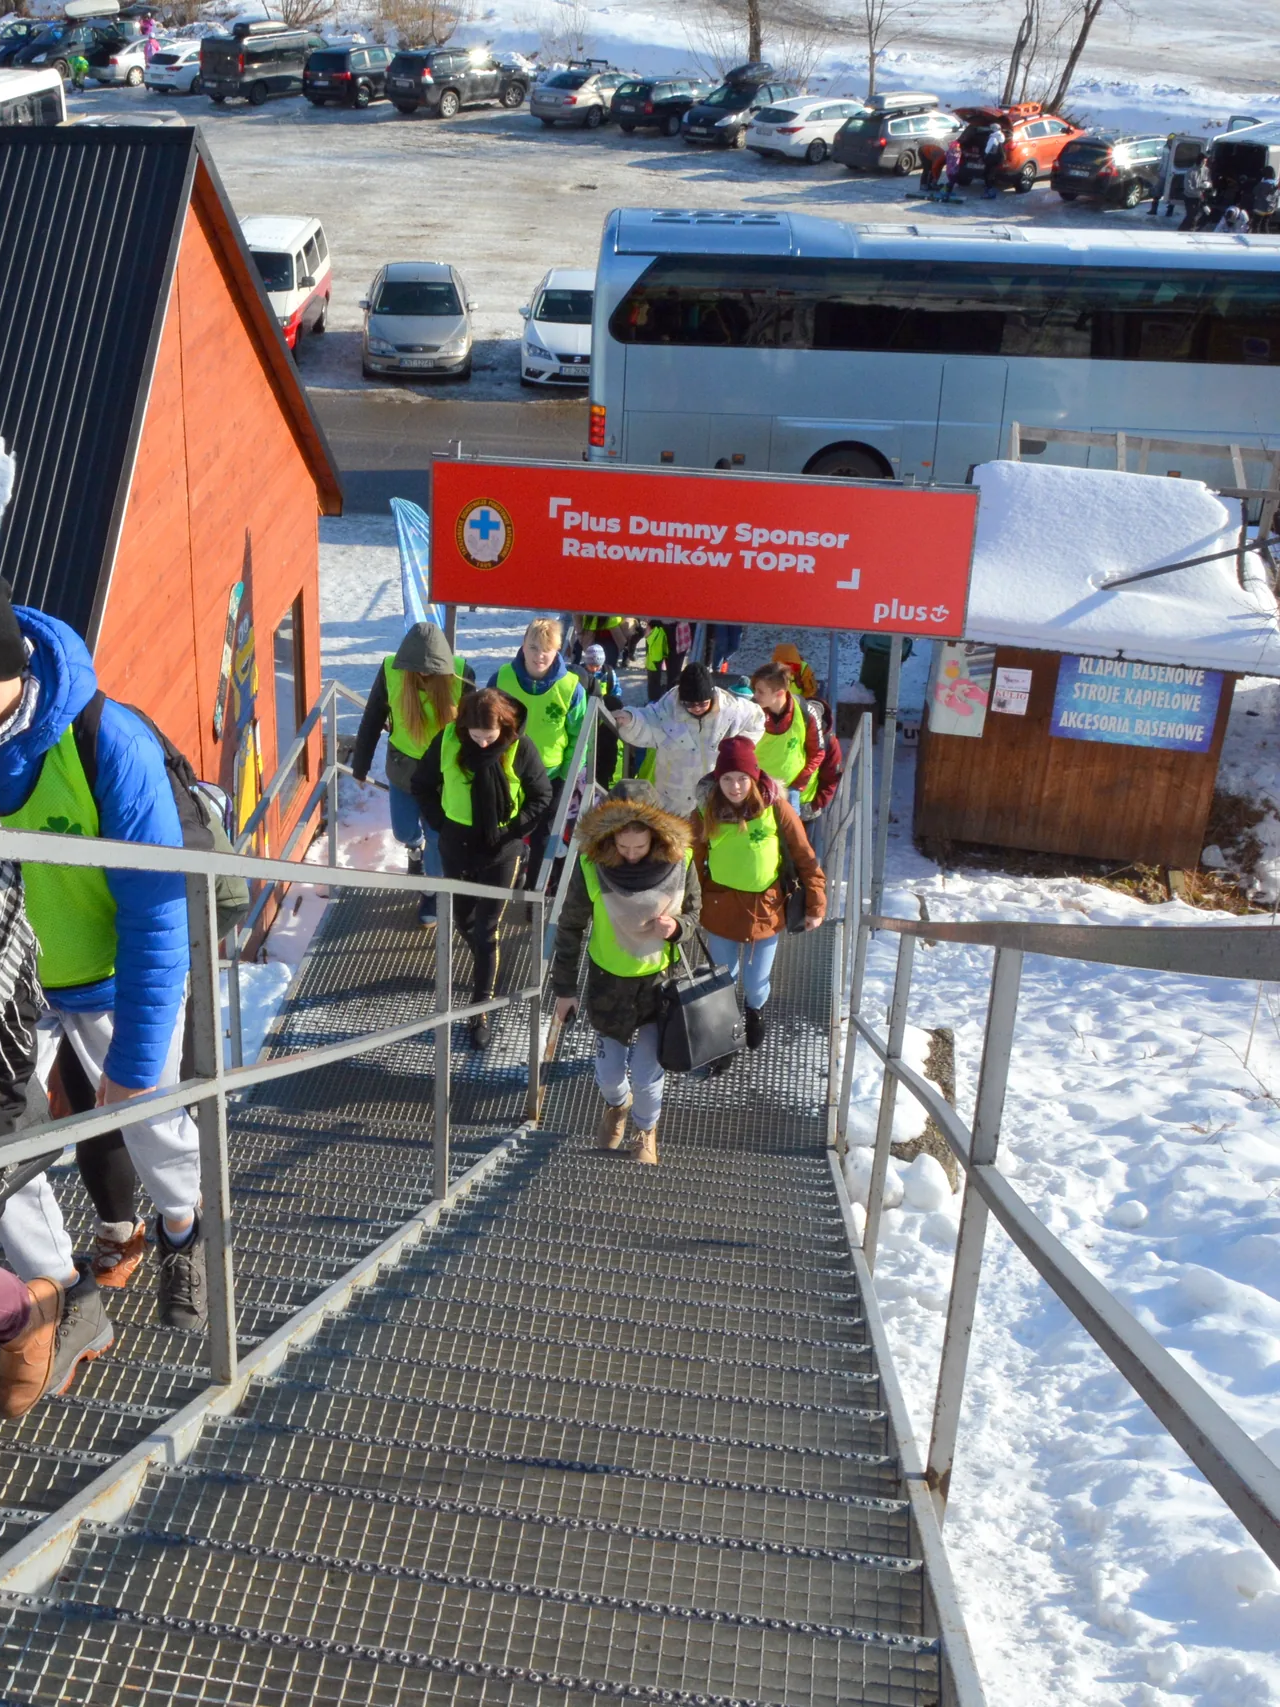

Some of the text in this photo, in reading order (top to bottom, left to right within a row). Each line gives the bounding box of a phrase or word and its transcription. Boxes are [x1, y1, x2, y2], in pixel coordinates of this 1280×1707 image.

[563, 511, 850, 549] Plus Dumny Sponsor
[562, 537, 816, 574] Ratowników TOPR
[873, 598, 928, 624] plus
[1078, 657, 1205, 687] KLAPKI BASENOWE
[1073, 682, 1202, 712] STROJE KĄPIELOWE
[1059, 711, 1205, 742] AKCESORIA BASENOWE
